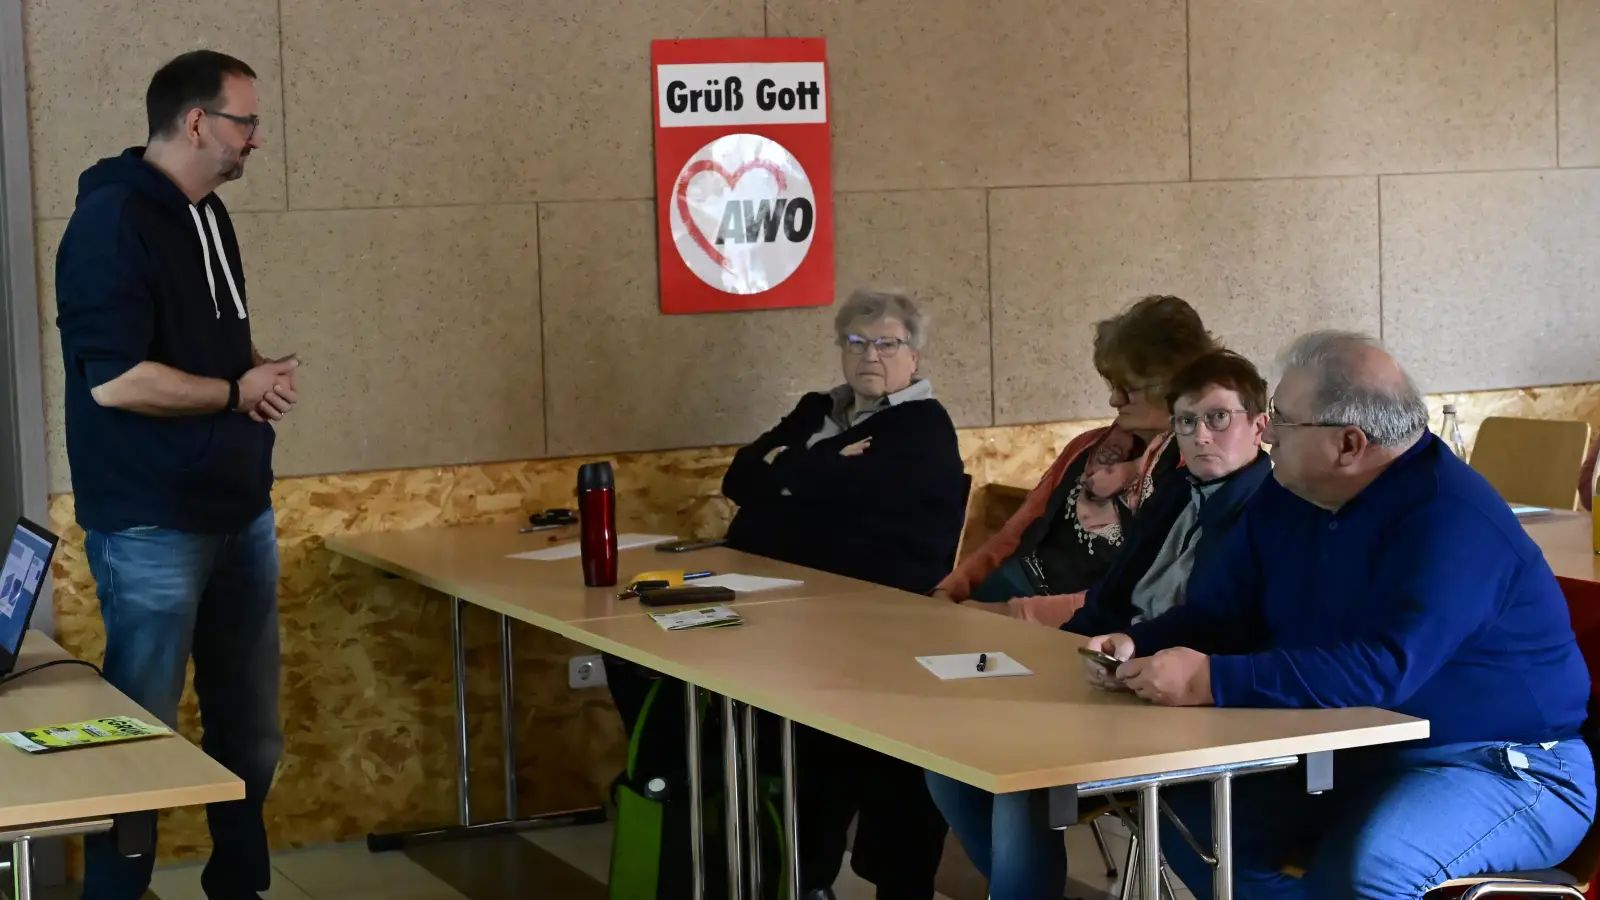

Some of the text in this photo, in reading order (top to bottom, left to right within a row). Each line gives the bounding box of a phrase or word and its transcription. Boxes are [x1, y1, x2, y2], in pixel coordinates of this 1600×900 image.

[666, 76, 820, 114] Grüß Gott
[715, 196, 814, 245] AWO
